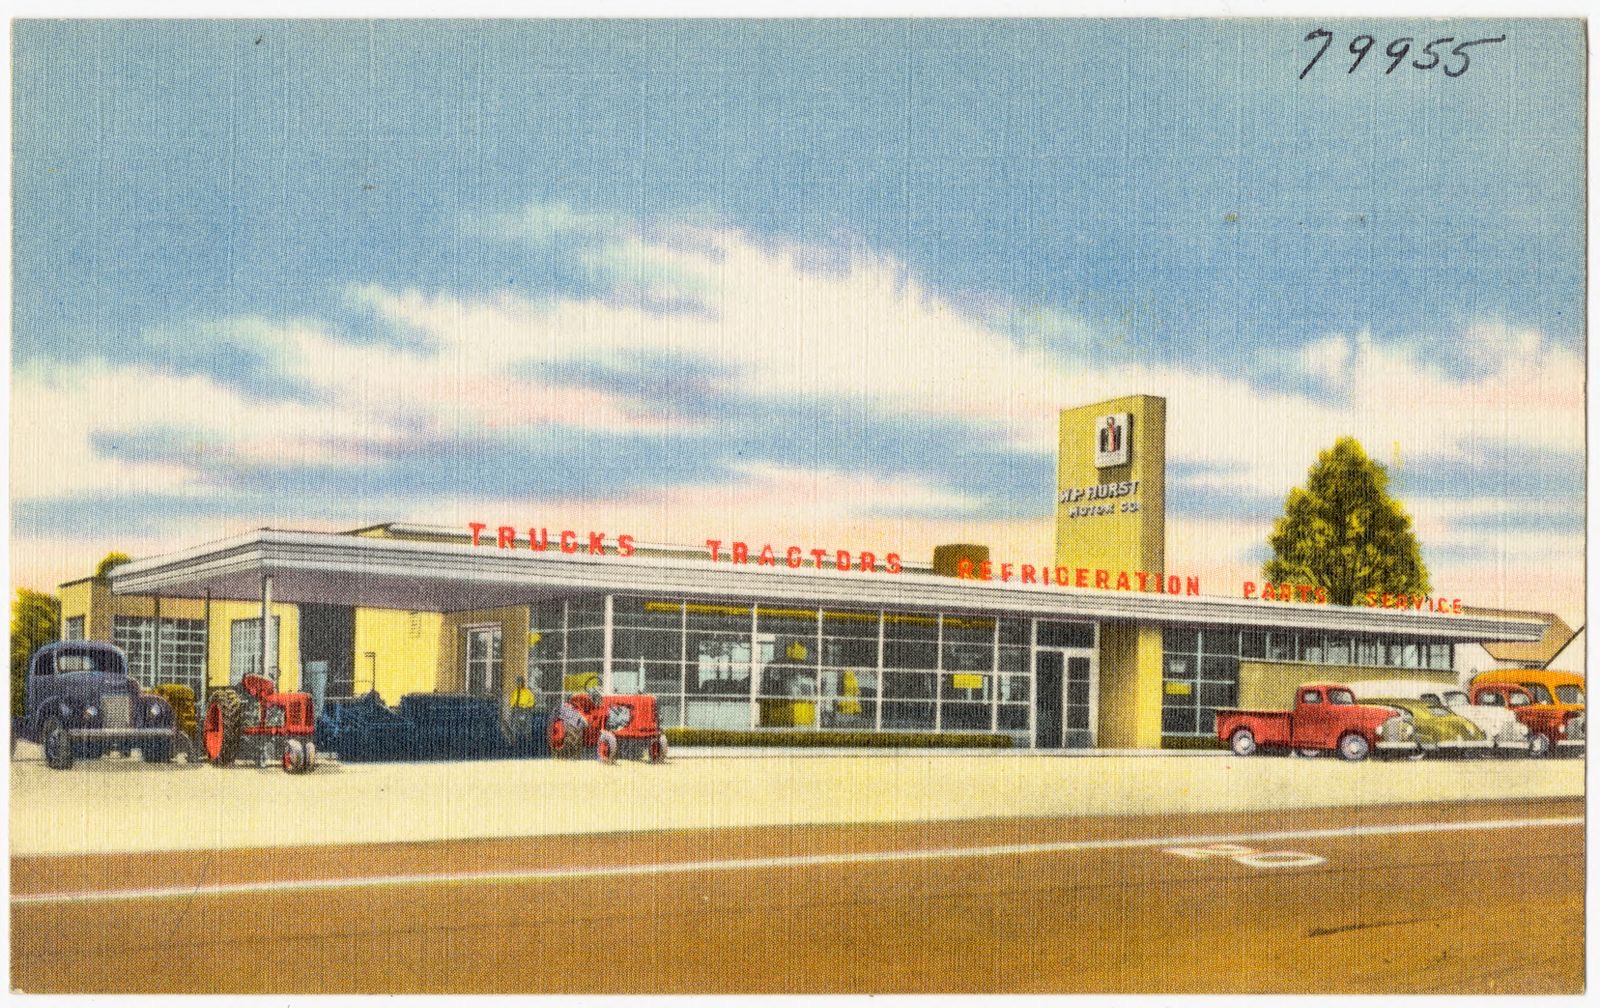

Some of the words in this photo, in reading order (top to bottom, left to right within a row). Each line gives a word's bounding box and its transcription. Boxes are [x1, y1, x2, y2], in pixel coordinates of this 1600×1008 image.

[1299, 27, 1506, 80] 79955
[1087, 480, 1140, 500] HURST
[468, 522, 636, 557] TRUCKS
[706, 539, 902, 575] TRACTORS
[957, 556, 1201, 596] REFRIGERATION
[1242, 581, 1328, 605] PARTS
[1365, 591, 1463, 615] SERVICE
